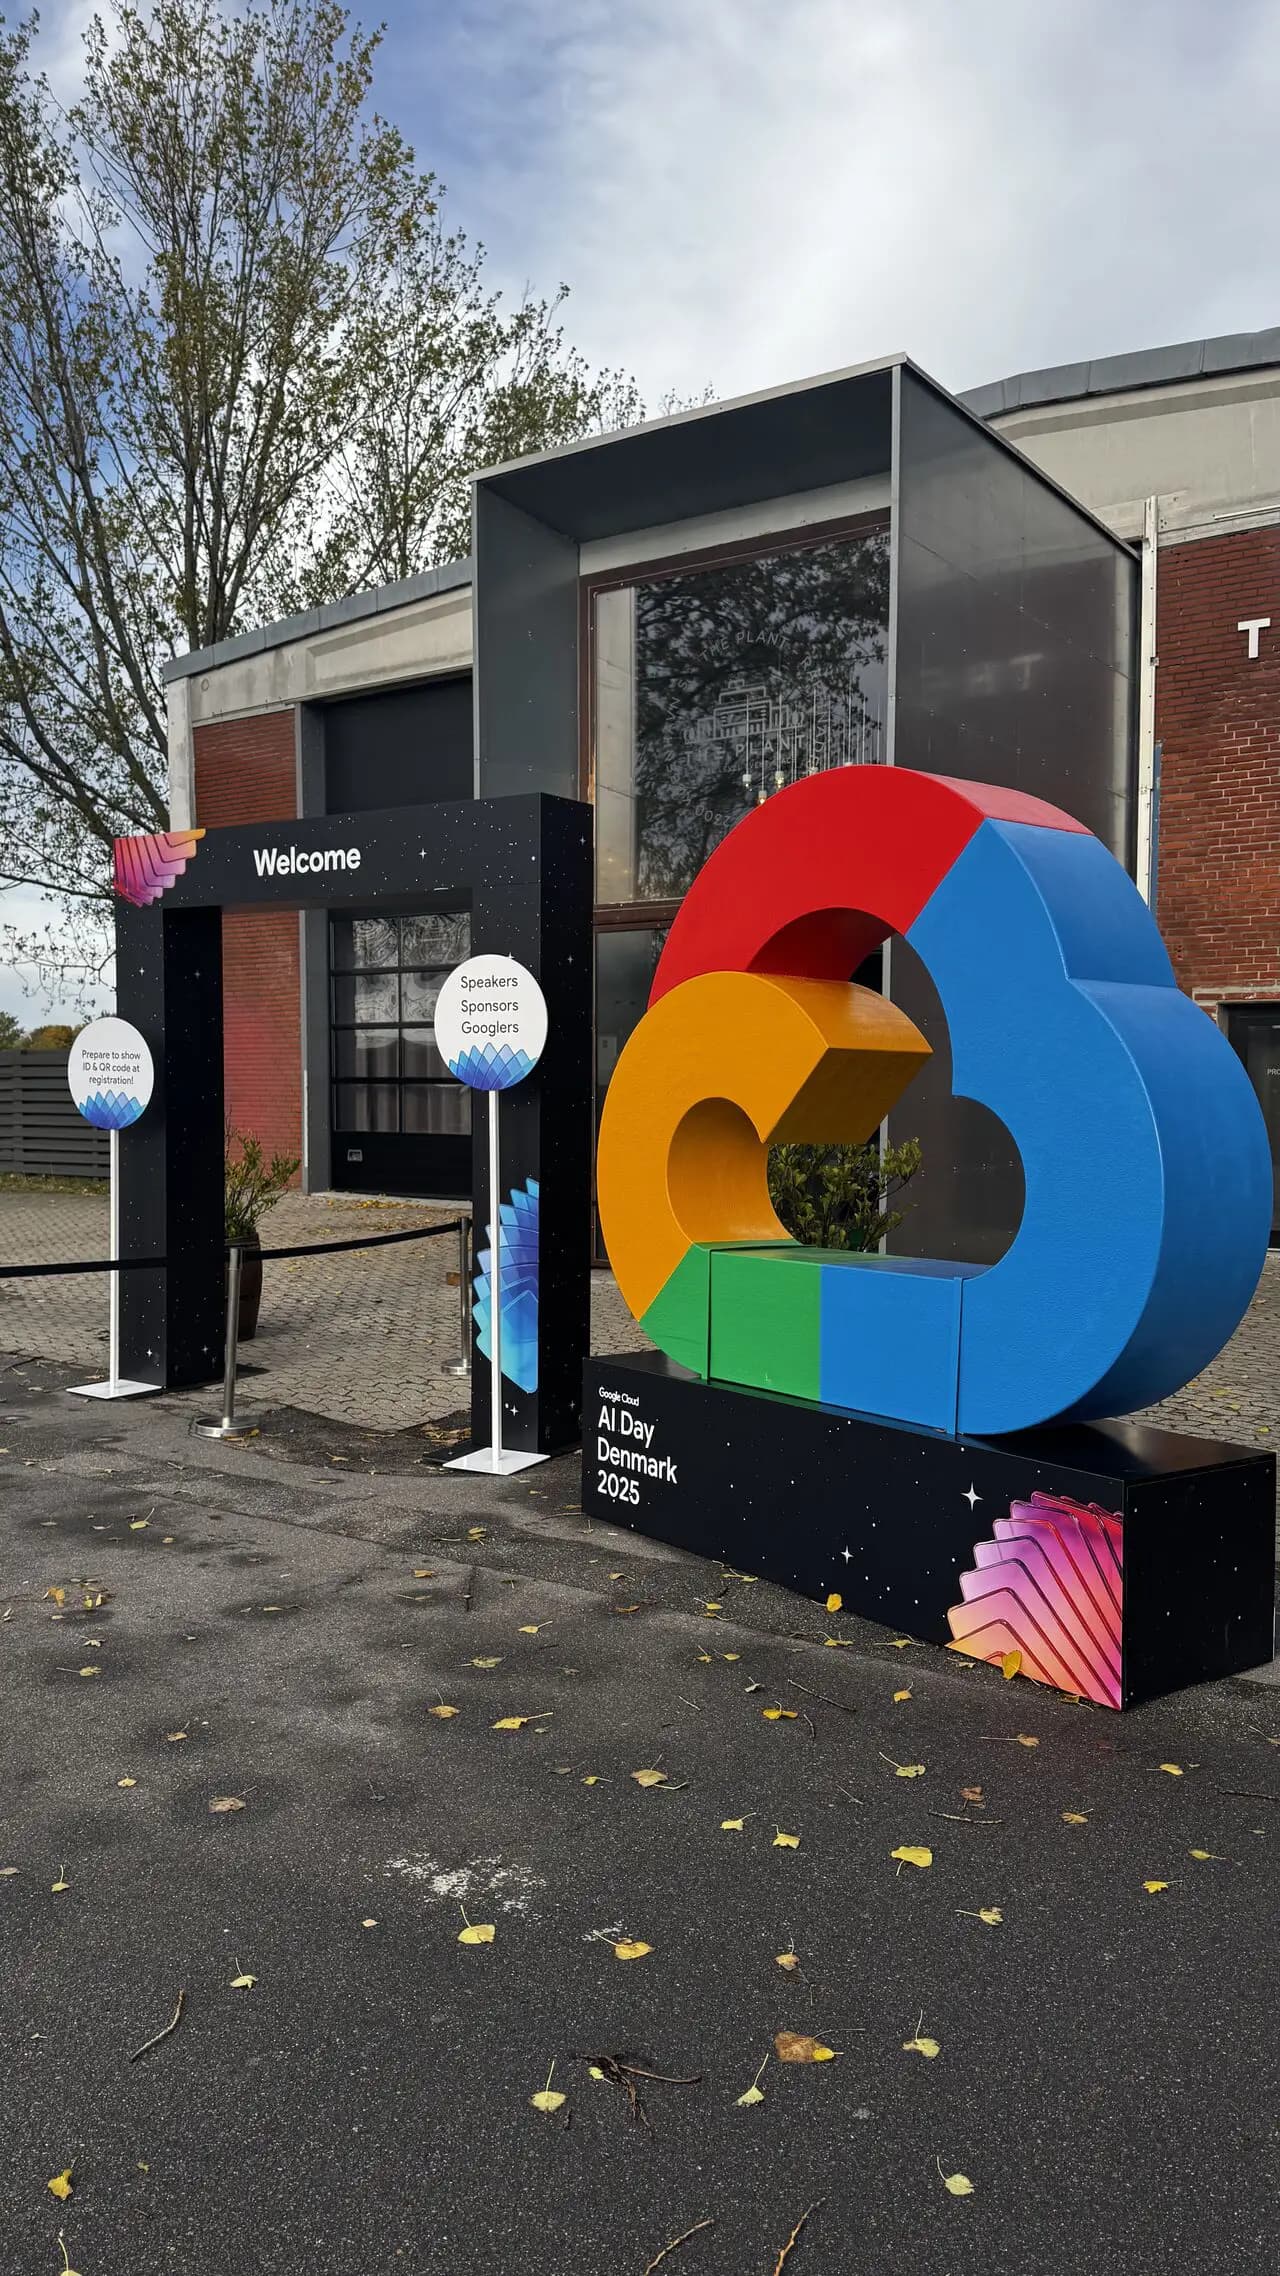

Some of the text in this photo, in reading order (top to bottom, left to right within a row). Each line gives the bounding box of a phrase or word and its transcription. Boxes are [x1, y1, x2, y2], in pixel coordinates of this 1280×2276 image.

[699, 629, 790, 661] THE PLANT
[736, 734, 805, 757] PLANT
[253, 846, 361, 877] Welcome
[460, 974, 518, 992] Speakers
[461, 999, 519, 1015] Sponsors
[461, 1020, 519, 1037] Googlers
[82, 1049, 141, 1060] Prepare to show
[83, 1062, 91, 1071] ID
[99, 1063, 111, 1072] QR
[112, 1064, 131, 1072] code
[132, 1065, 141, 1073] at
[89, 1075, 134, 1086] registration!
[599, 1386, 640, 1406] Google Cloud
[598, 1405, 655, 1449] AI Day
[597, 1436, 678, 1484] Denmark
[597, 1469, 640, 1505] 2025
